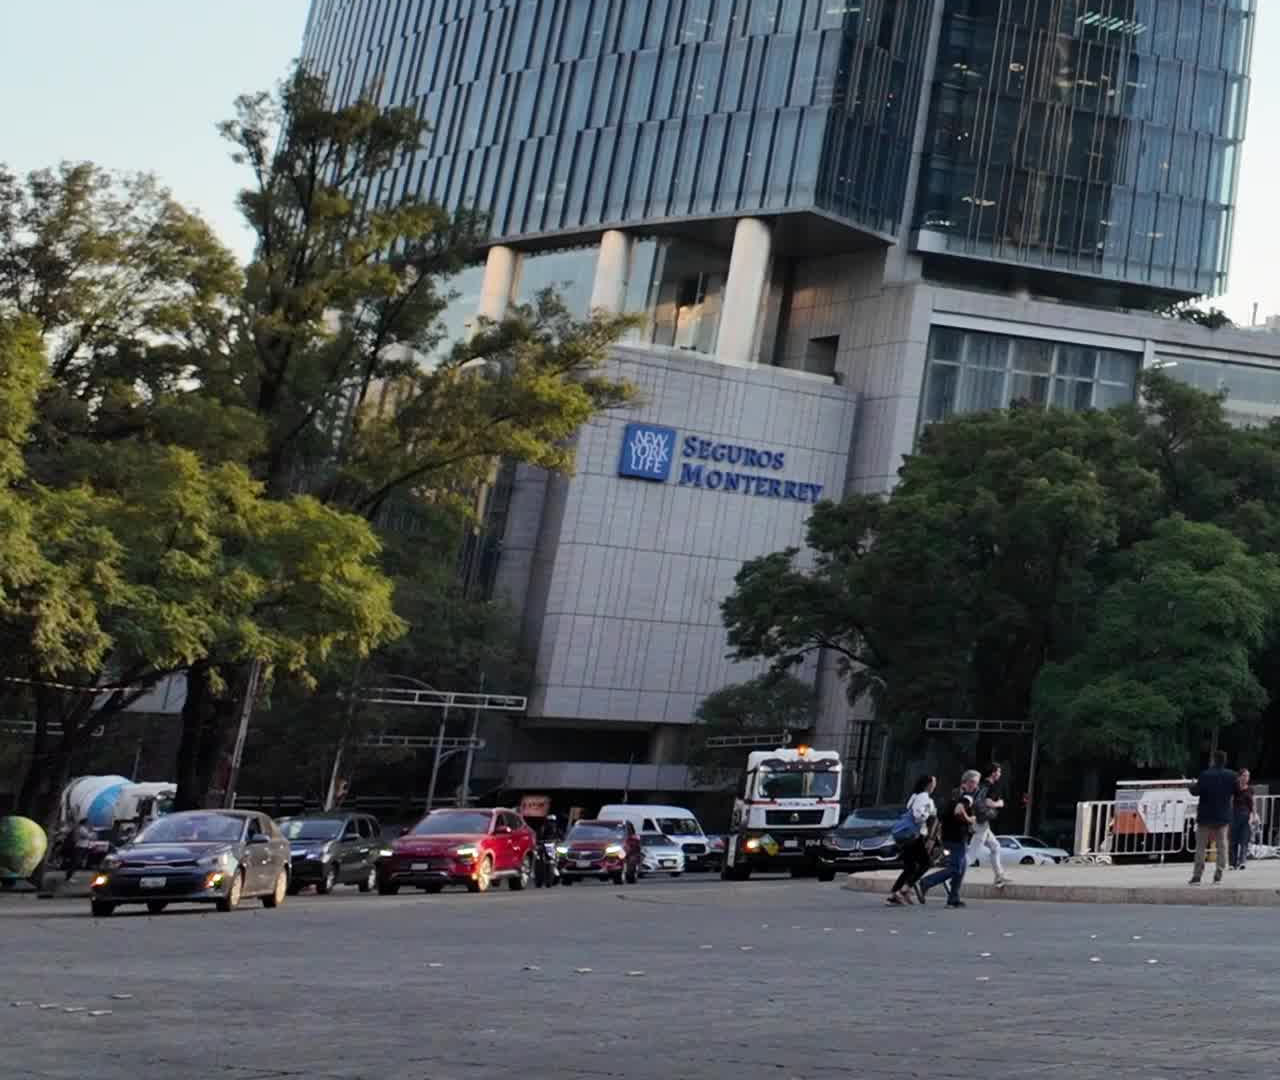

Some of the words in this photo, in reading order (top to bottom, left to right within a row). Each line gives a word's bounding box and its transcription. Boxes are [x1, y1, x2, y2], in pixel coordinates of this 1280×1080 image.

[634, 430, 669, 447] NEW
[630, 441, 669, 462] YORK
[682, 435, 785, 470] SEGUROS
[631, 455, 664, 473] LIFE
[680, 462, 823, 504] MONTERREY
